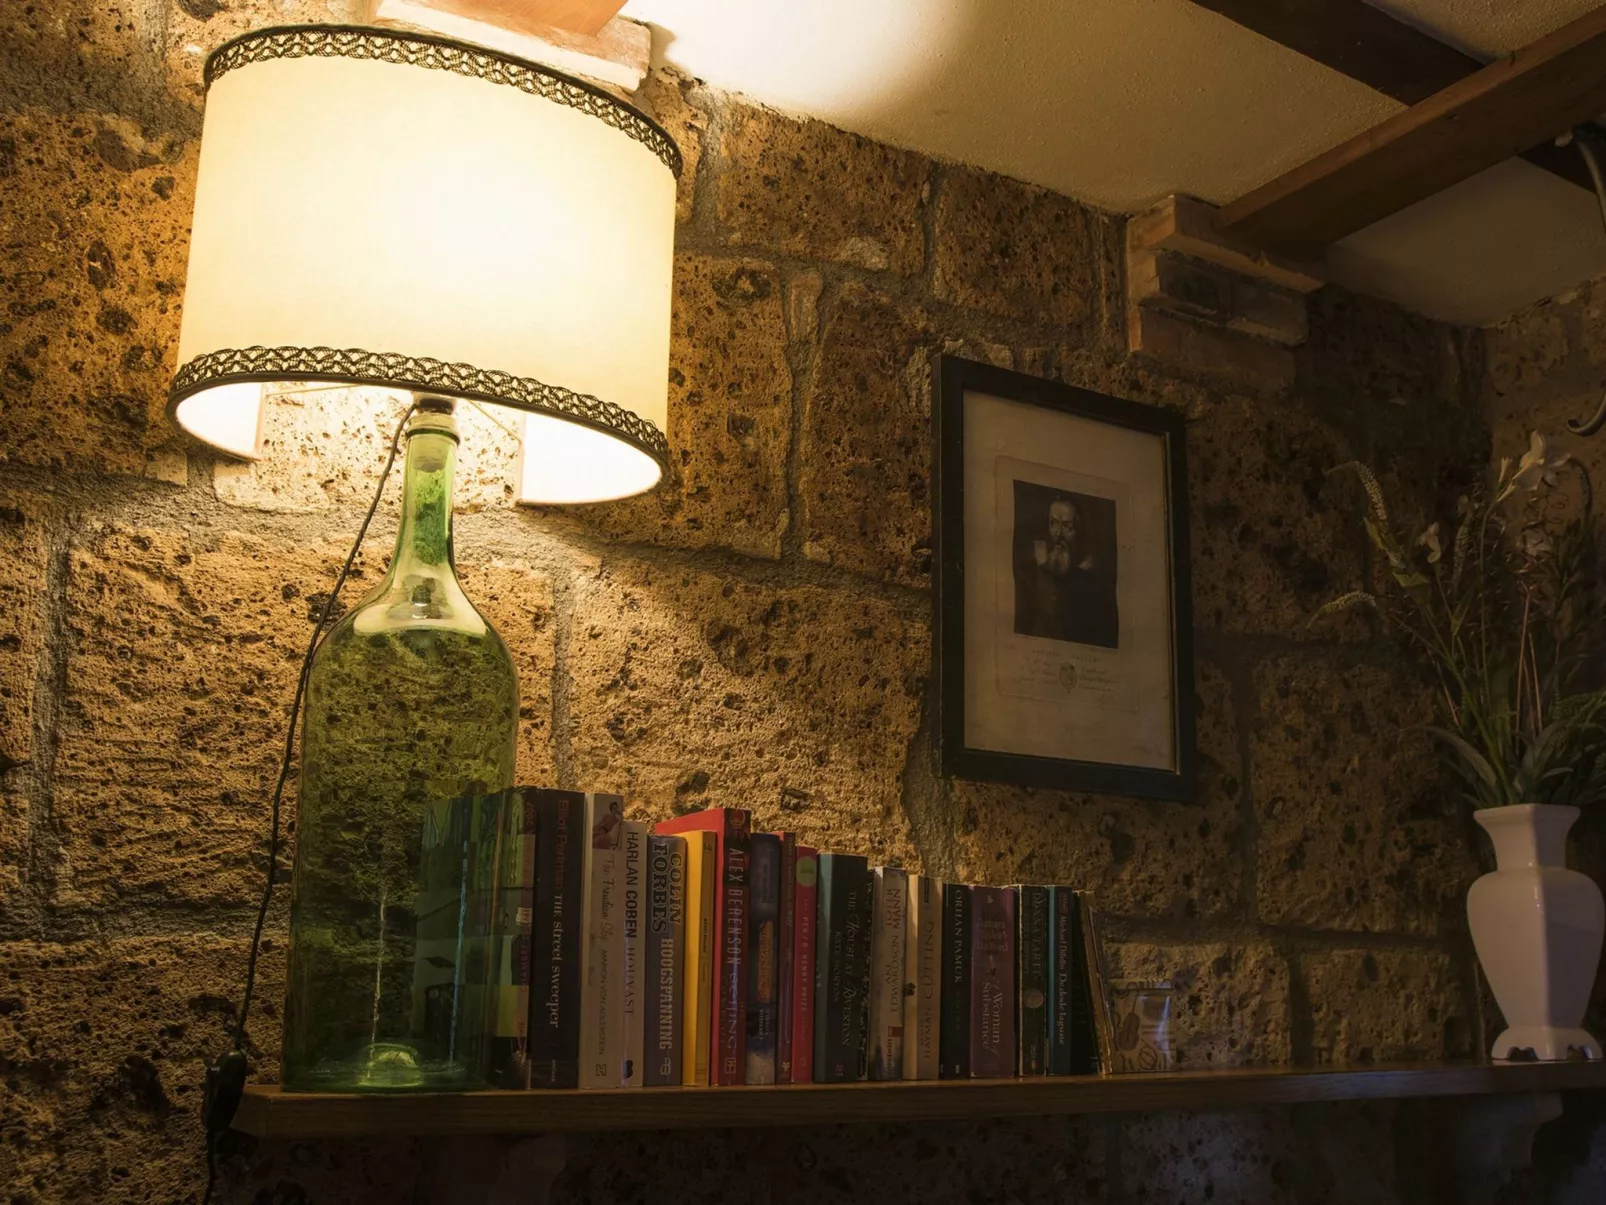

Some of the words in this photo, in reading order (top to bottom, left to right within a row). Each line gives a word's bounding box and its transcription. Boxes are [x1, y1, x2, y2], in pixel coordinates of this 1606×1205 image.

[556, 799, 570, 831] Elliot
[554, 834, 568, 889] Perlman
[603, 853, 617, 876] The
[625, 831, 640, 885] HARLAN
[729, 848, 745, 884] ALEX
[552, 893, 564, 918] THE
[651, 843, 669, 934] FORBES
[668, 852, 683, 926] COLIN
[848, 891, 857, 911] THE
[893, 888, 901, 930] MANN
[625, 890, 639, 939] COBEN
[726, 889, 744, 965] BERENSON
[954, 890, 964, 936] ORHAN
[1031, 892, 1043, 933] DONNA
[1059, 915, 1068, 944] Michael
[551, 920, 564, 962] street
[834, 931, 843, 956] KATE
[845, 914, 860, 961] HOUSE
[1031, 937, 1042, 976] TARTT
[1059, 945, 1068, 970] Dibdin
[600, 950, 609, 983] MARION
[624, 947, 637, 1016] HOUVAST
[800, 953, 808, 983] HENRY
[832, 961, 842, 1003] MORTON
[844, 963, 853, 977] AT
[890, 936, 900, 1013] EDWARDSON
[953, 939, 964, 983] PAMUK
[1059, 973, 1068, 987] De
[545, 965, 561, 1029] sweeper
[598, 984, 608, 1004] VON
[658, 937, 675, 1050] HOOGSPANNING
[726, 972, 740, 1050] BEIJING
[799, 986, 808, 1012] PRIZE
[842, 980, 857, 1047] RIVERTON
[1059, 988, 1068, 1011] dode
[597, 1005, 607, 1055] ADLERSTEIN
[923, 1007, 932, 1059] HAYMAN
[980, 981, 992, 1049] Substance
[992, 991, 1003, 1043] Woman
[1056, 1012, 1067, 1045] lagune
